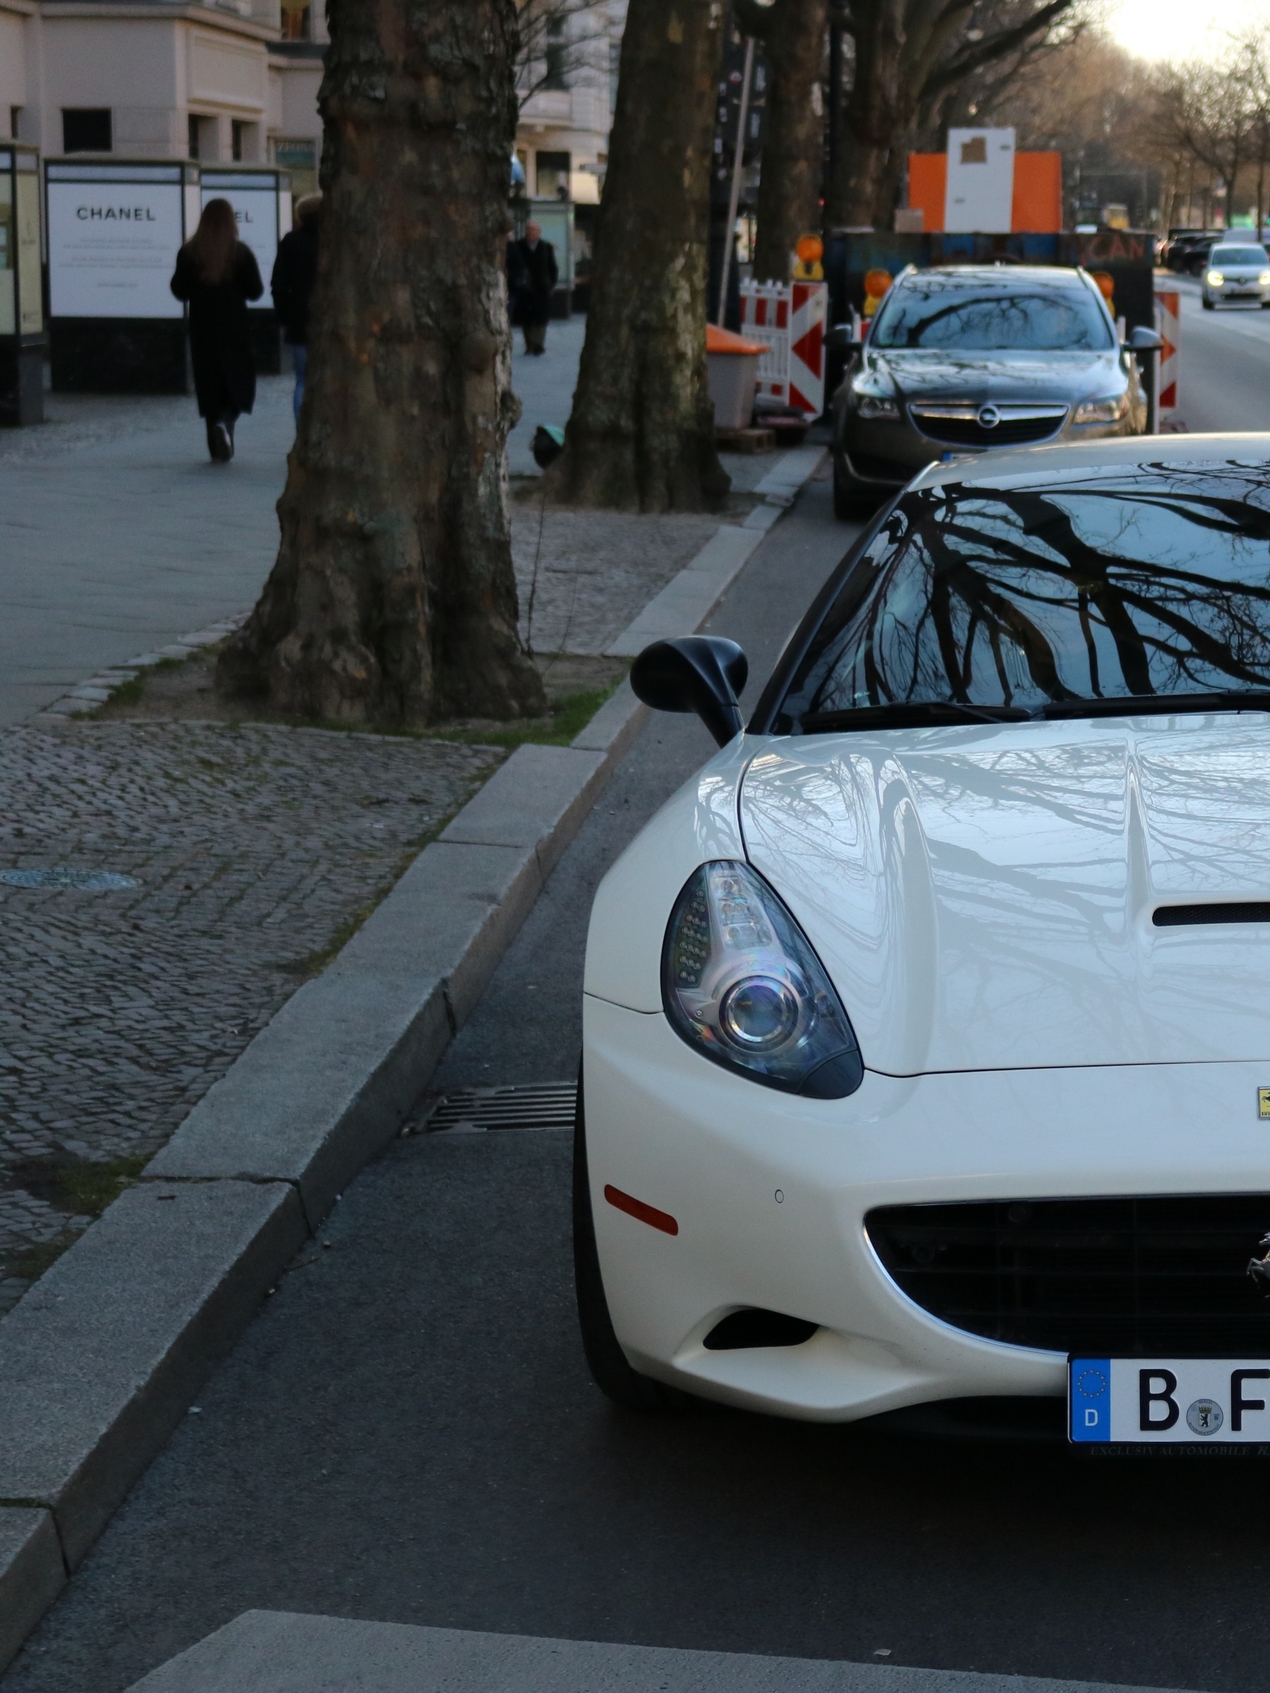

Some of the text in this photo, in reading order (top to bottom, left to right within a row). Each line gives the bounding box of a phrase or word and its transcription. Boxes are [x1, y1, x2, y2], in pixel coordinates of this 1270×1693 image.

[76, 206, 156, 221] CHANEL
[1138, 1368, 1180, 1432] B
[1085, 1409, 1099, 1426] D
[1090, 1446, 1156, 1456] EXCLUSIV
[1159, 1446, 1251, 1456] AUTOMOBILE
